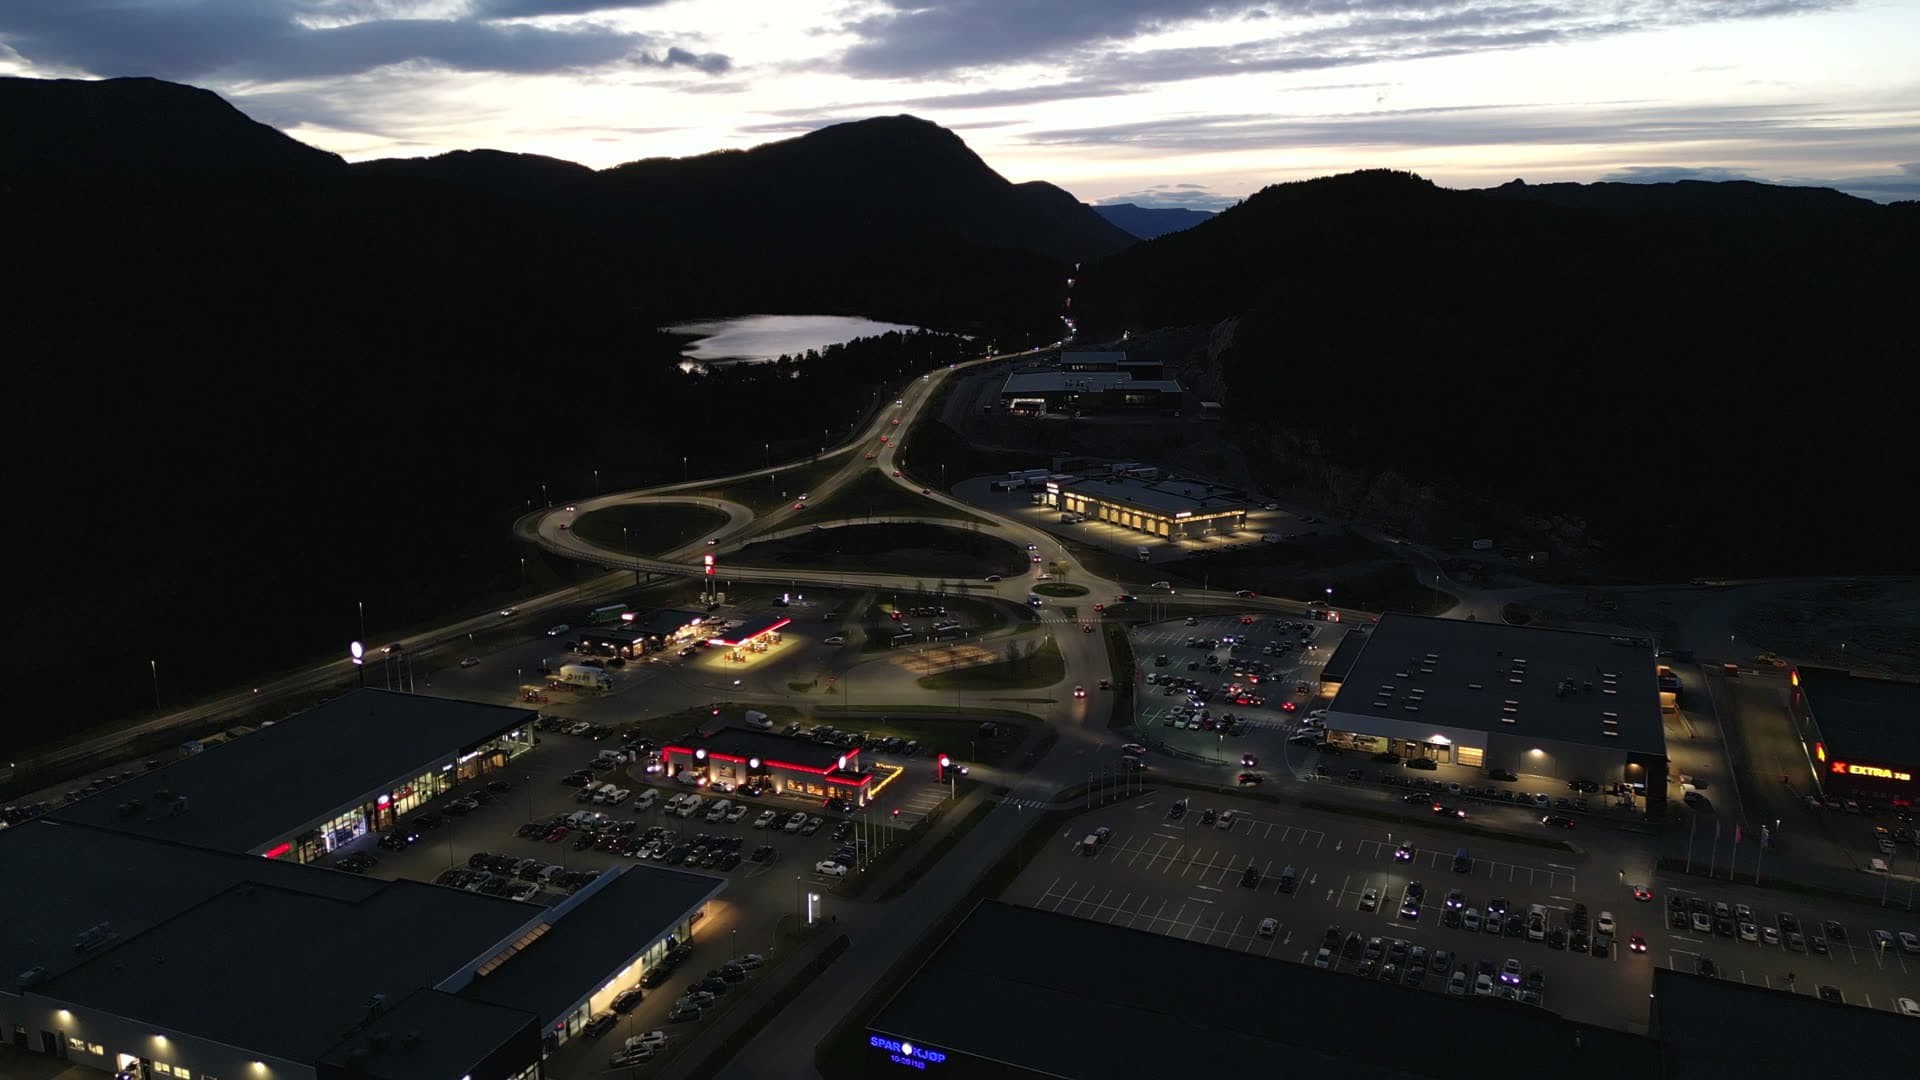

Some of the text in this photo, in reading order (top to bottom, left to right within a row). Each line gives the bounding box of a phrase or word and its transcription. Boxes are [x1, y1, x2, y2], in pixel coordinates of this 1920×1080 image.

[1849, 765, 1892, 778] EXTRA
[871, 1037, 946, 1062] SPAR KJØP
